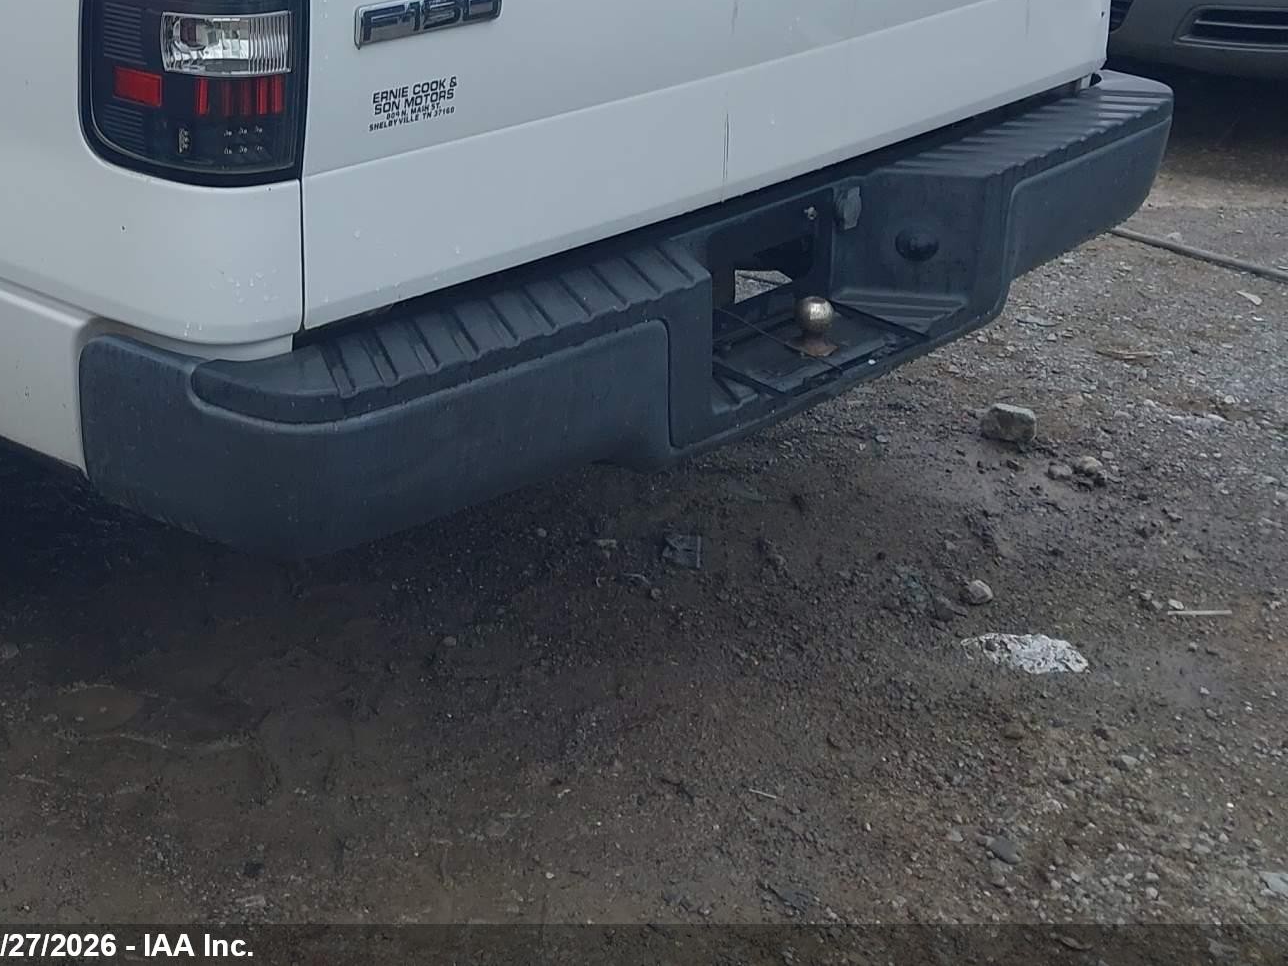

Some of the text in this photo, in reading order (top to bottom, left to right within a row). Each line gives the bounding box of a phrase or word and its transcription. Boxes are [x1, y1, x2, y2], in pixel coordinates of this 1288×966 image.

[372, 76, 457, 104] ERNIE COOK &
[374, 88, 454, 115] SON MOTORS
[369, 105, 455, 132] SHELBYVILLE TN 37160
[410, 104, 430, 115] MAIN
